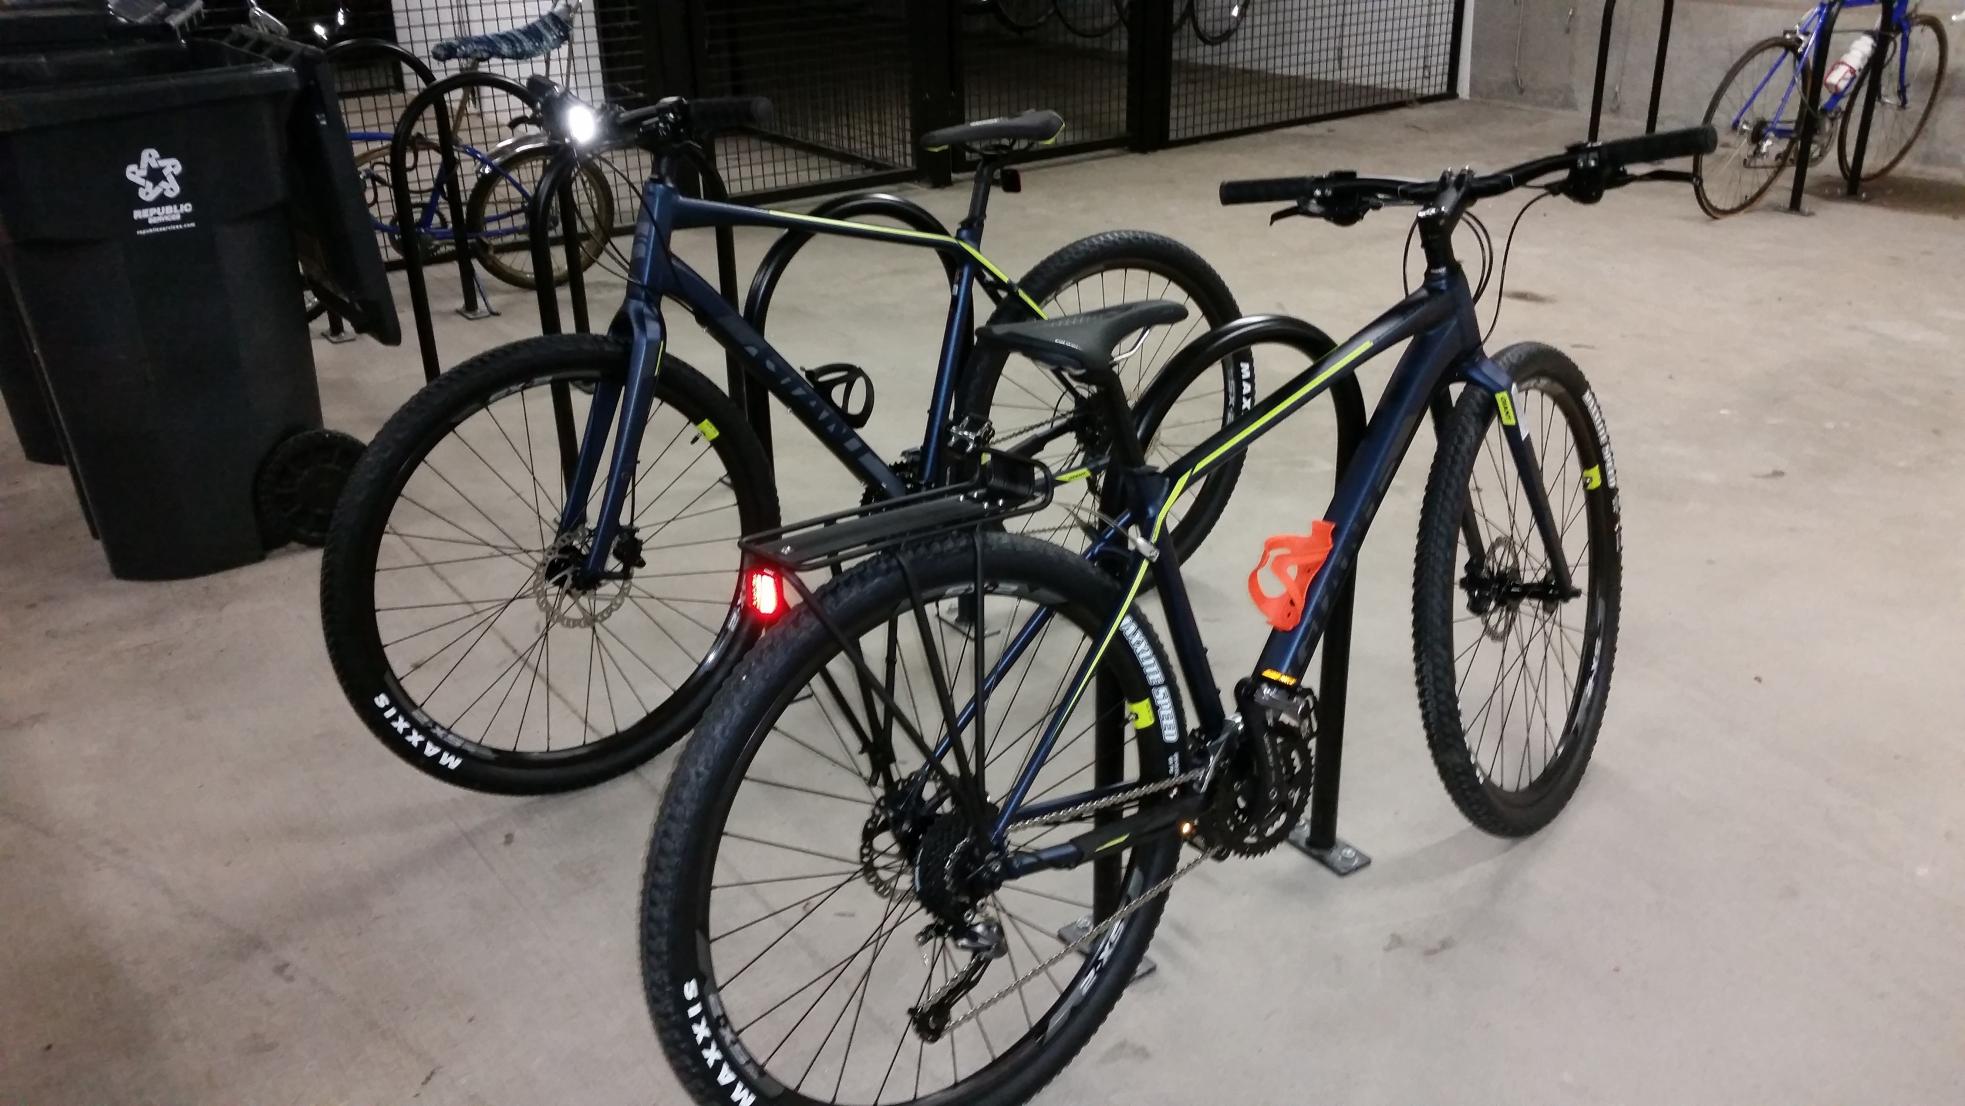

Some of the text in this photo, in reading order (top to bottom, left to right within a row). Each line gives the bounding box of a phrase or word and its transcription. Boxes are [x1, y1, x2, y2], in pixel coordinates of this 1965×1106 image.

[132, 202, 193, 220] REPUBLIC
[1240, 362, 1251, 414] MAX
[373, 692, 462, 770] MAXXIS
[1152, 685, 1180, 743] SPEED
[683, 978, 757, 1106] MAXXIS
